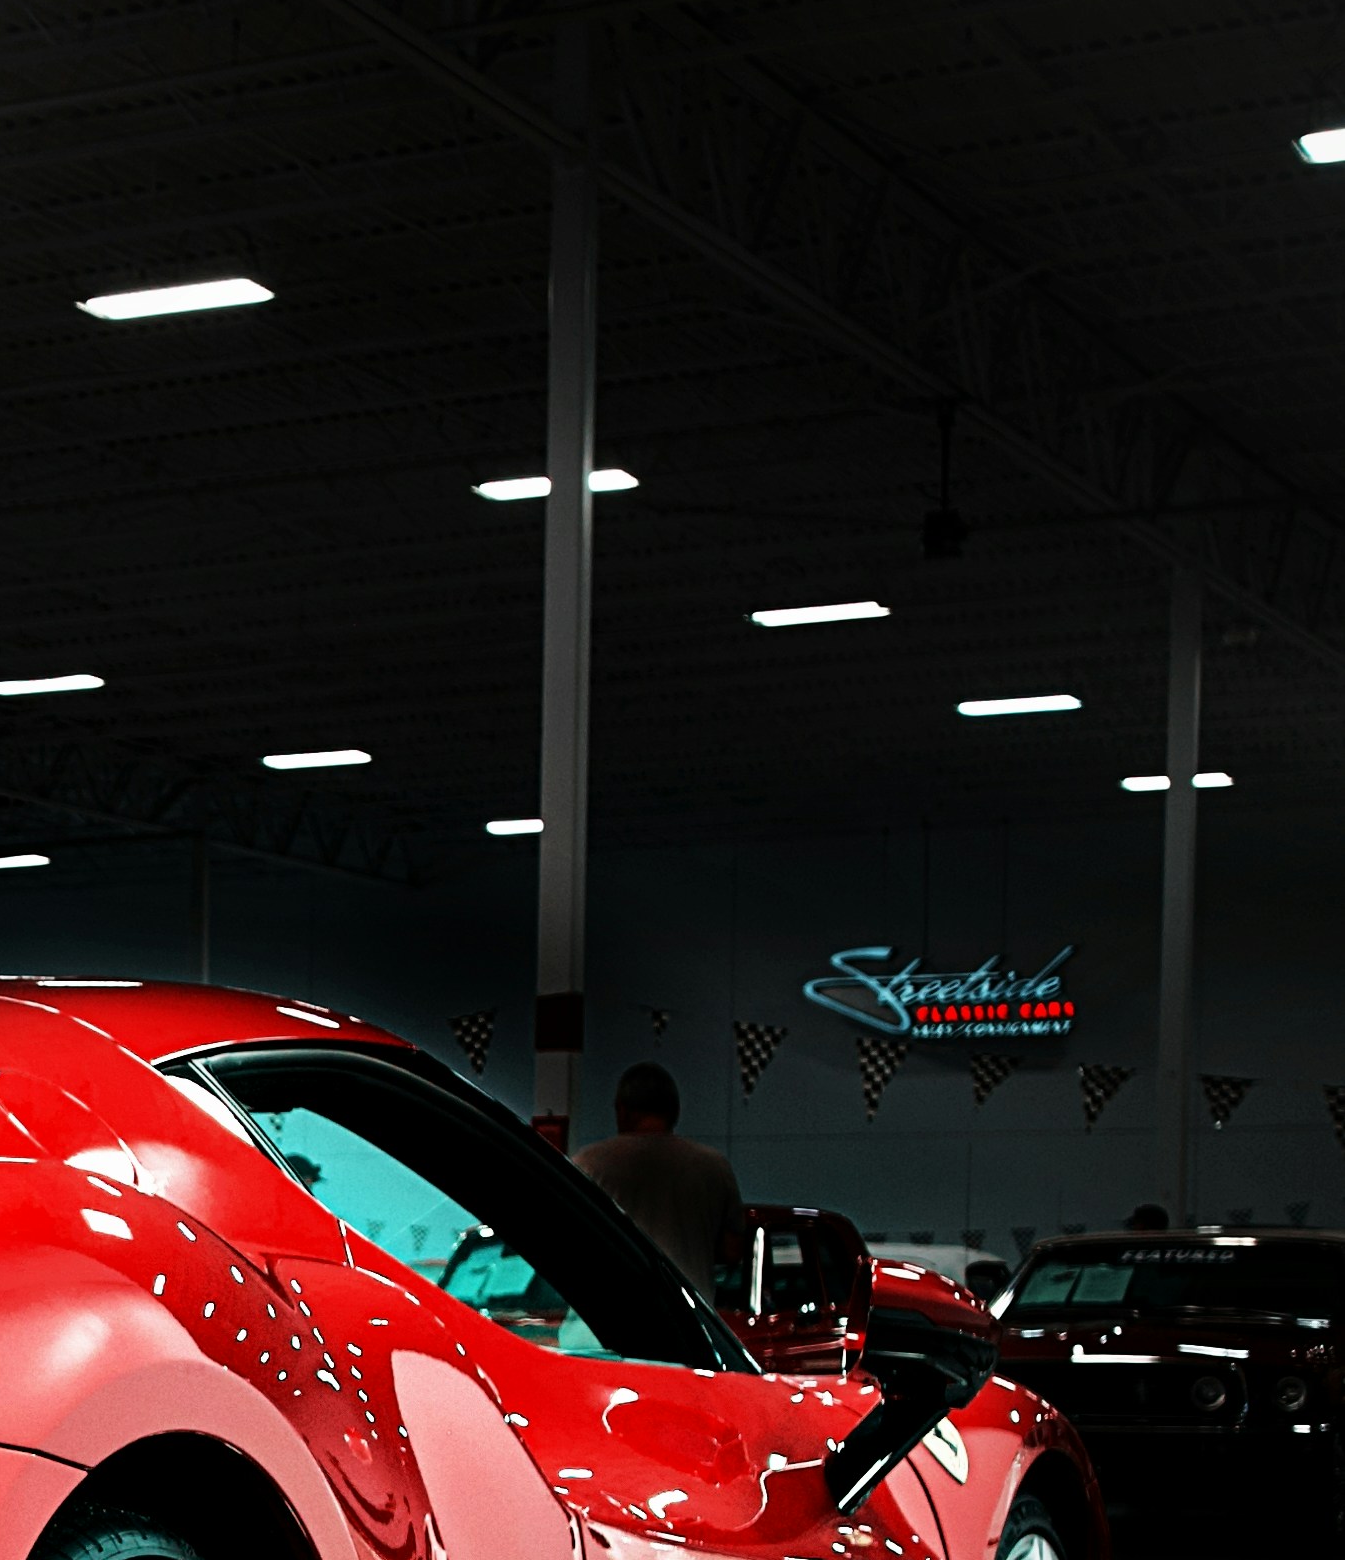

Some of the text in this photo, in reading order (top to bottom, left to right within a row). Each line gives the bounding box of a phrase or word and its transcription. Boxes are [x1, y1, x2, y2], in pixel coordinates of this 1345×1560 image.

[802, 944, 1077, 1035] Streetside
[916, 1003, 1008, 1023] CLASSIC
[1120, 1249, 1236, 1263] FEATURED
